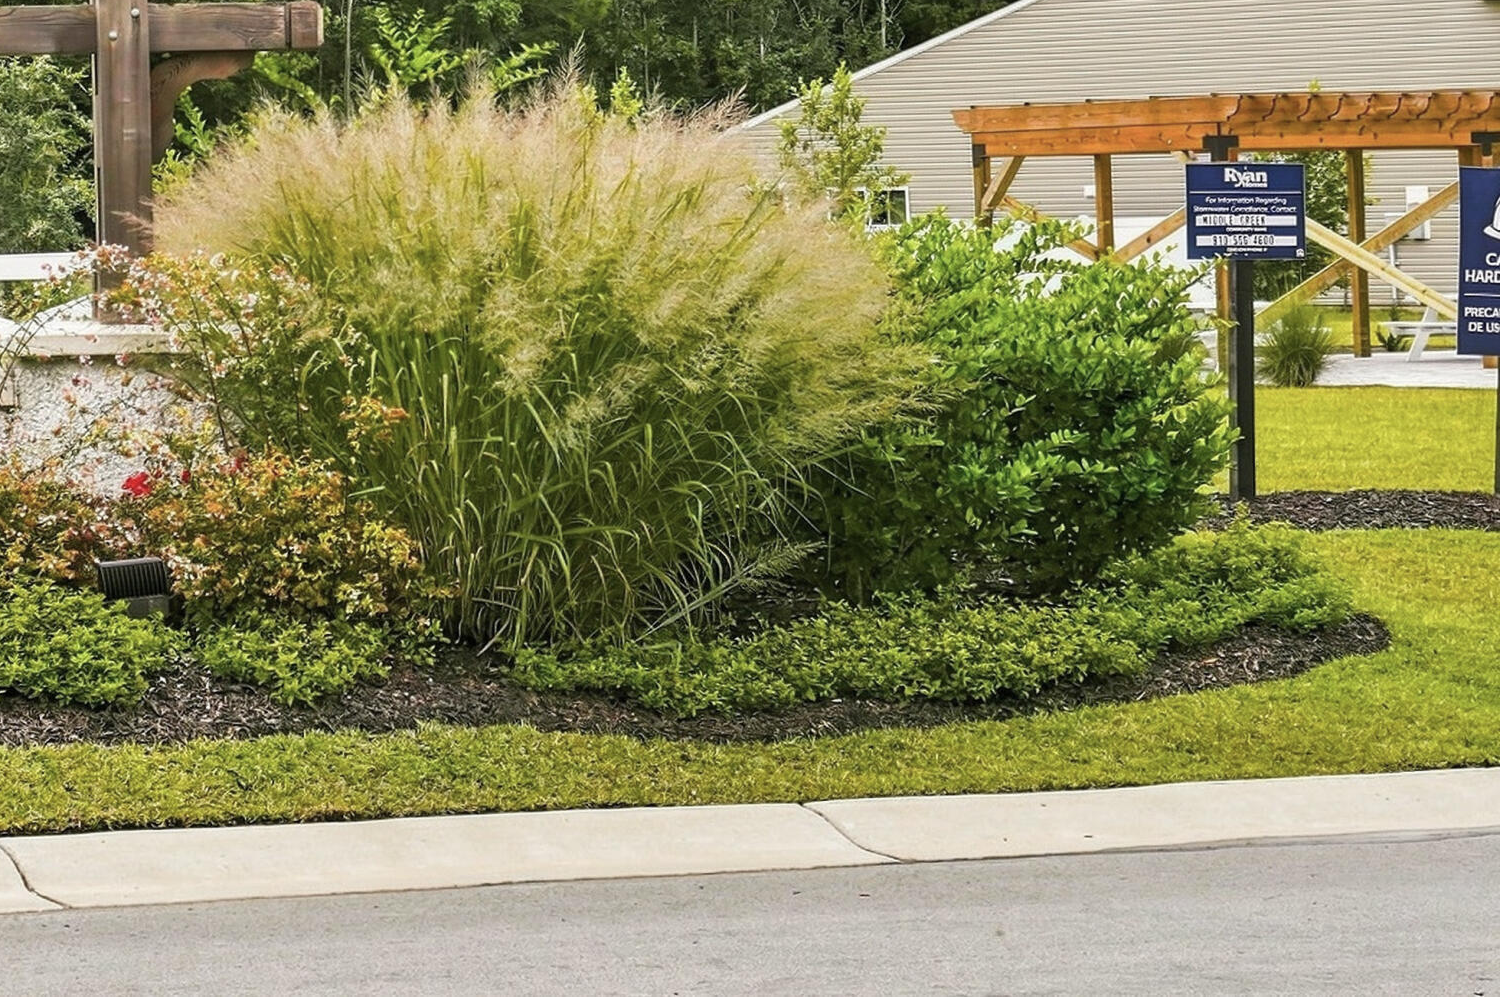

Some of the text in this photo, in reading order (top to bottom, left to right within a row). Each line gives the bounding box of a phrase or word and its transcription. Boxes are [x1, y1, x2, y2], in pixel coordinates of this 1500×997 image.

[1224, 167, 1267, 187] Ryan
[1255, 197, 1287, 205] Regarding
[1202, 216, 1266, 225] MIDDLE CREEK
[1212, 236, 1228, 245] 910
[1468, 322, 1484, 332] DE
